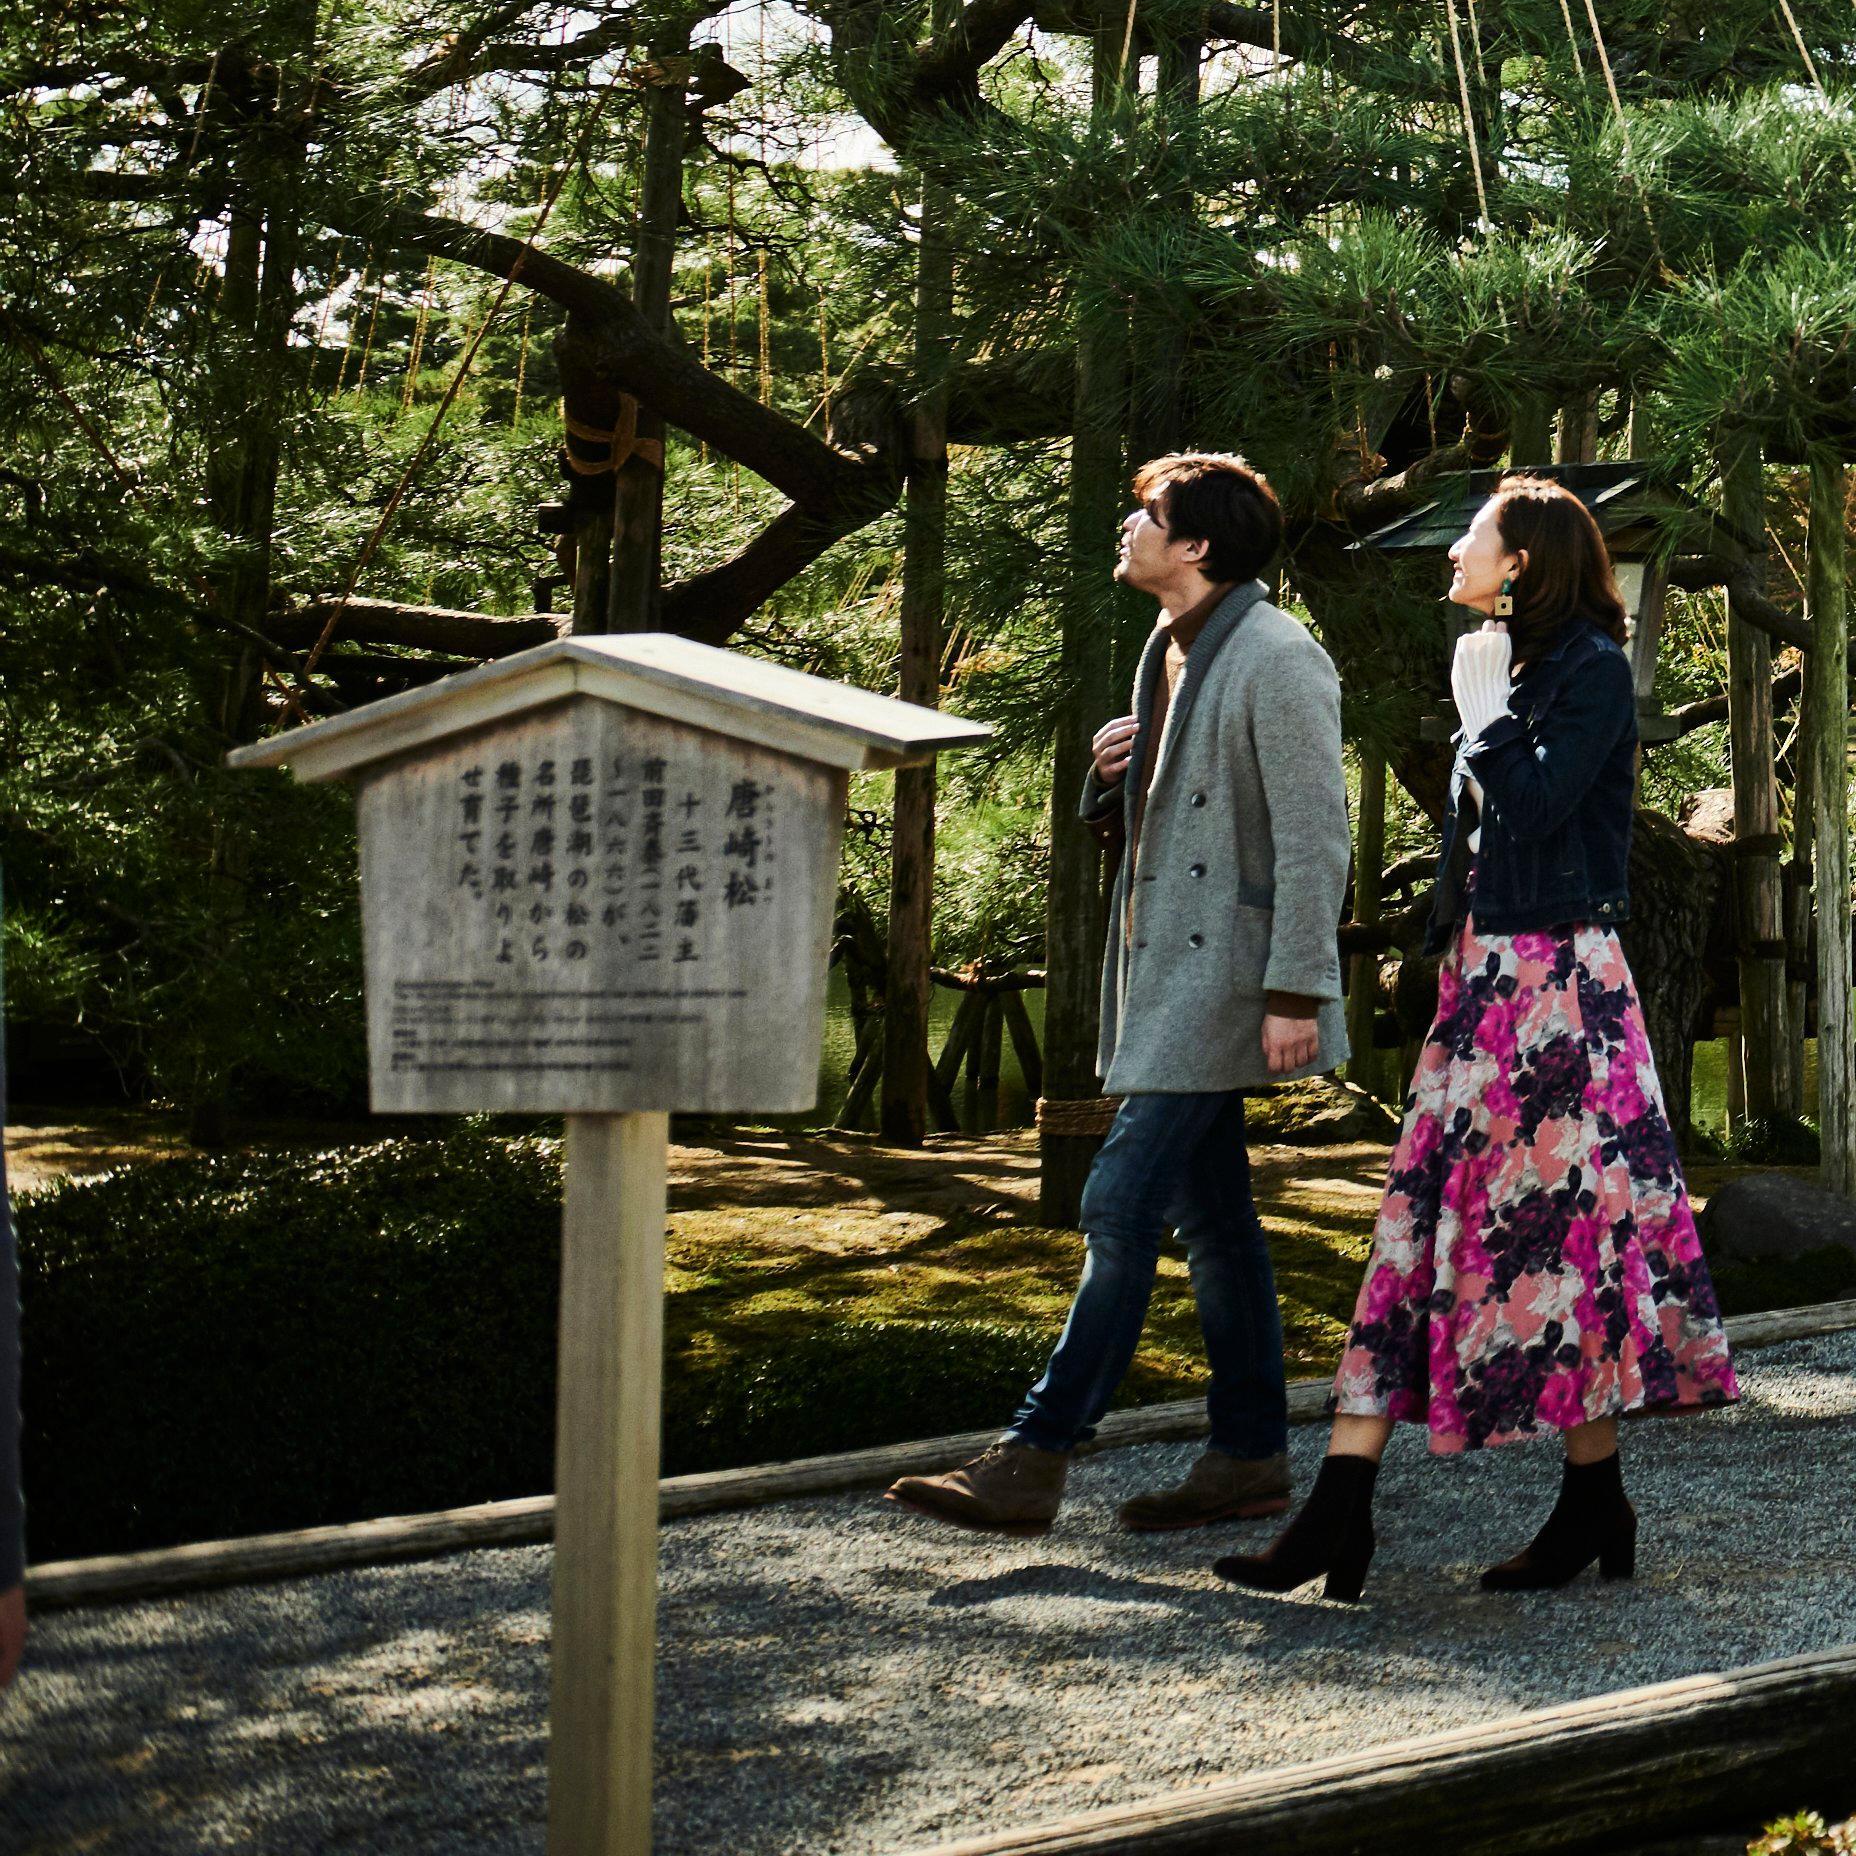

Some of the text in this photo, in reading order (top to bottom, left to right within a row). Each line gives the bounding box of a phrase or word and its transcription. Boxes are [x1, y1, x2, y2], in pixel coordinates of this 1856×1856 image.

[528, 760, 556, 962] 名所唐崎から
[565, 758, 594, 960] 琵琶湖の松の
[674, 793, 702, 963] 十三代藩主
[724, 778, 760, 909] 唐崎松
